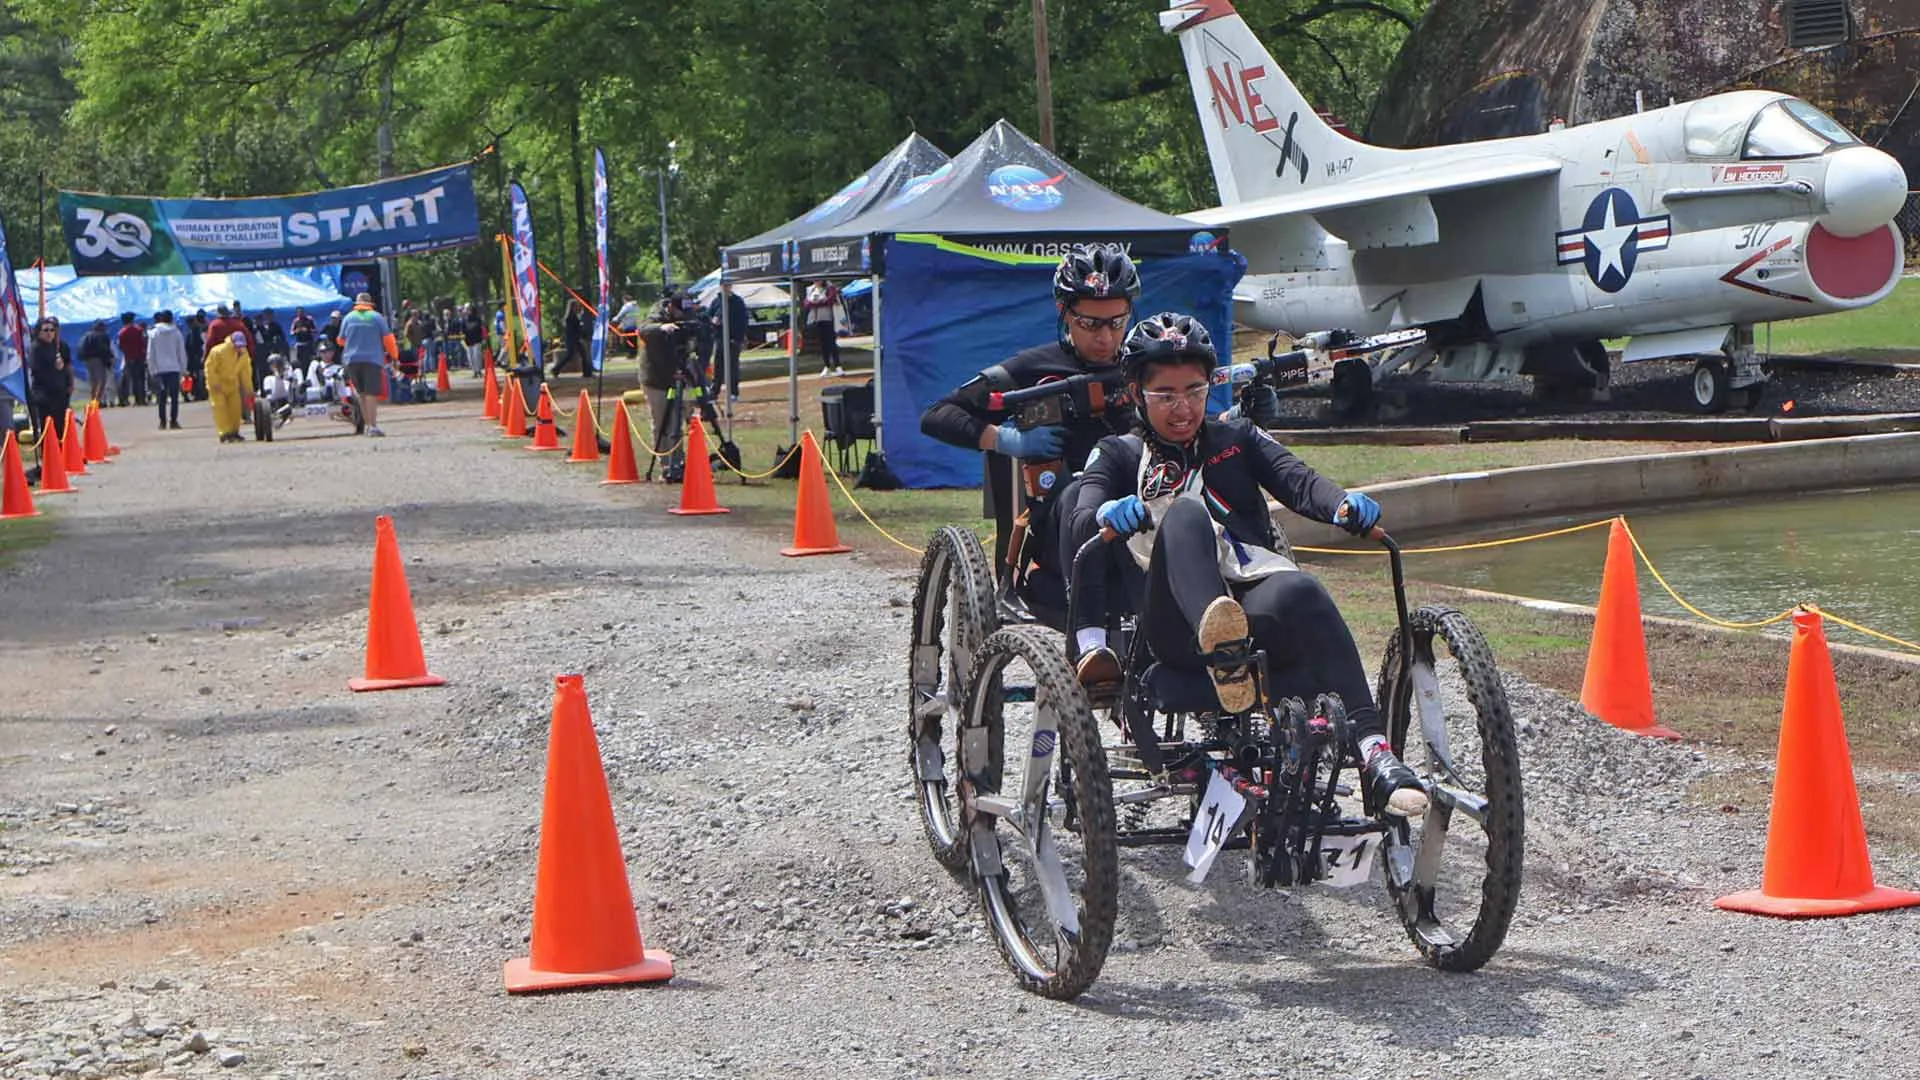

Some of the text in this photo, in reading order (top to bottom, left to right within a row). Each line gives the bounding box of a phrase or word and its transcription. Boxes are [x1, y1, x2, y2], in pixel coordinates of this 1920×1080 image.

[1207, 62, 1280, 135] NE
[1326, 157, 1353, 177] VA-147
[989, 184, 1063, 196] NASA
[288, 186, 445, 247] START
[75, 207, 152, 258] 30
[176, 221, 279, 233] HUMAN EXPLORATION
[190, 231, 278, 242] ROVER CHALLENGE
[1735, 222, 1777, 250] 317
[972, 243, 1132, 257] wwnasaov
[1280, 367, 1305, 381] PIPE
